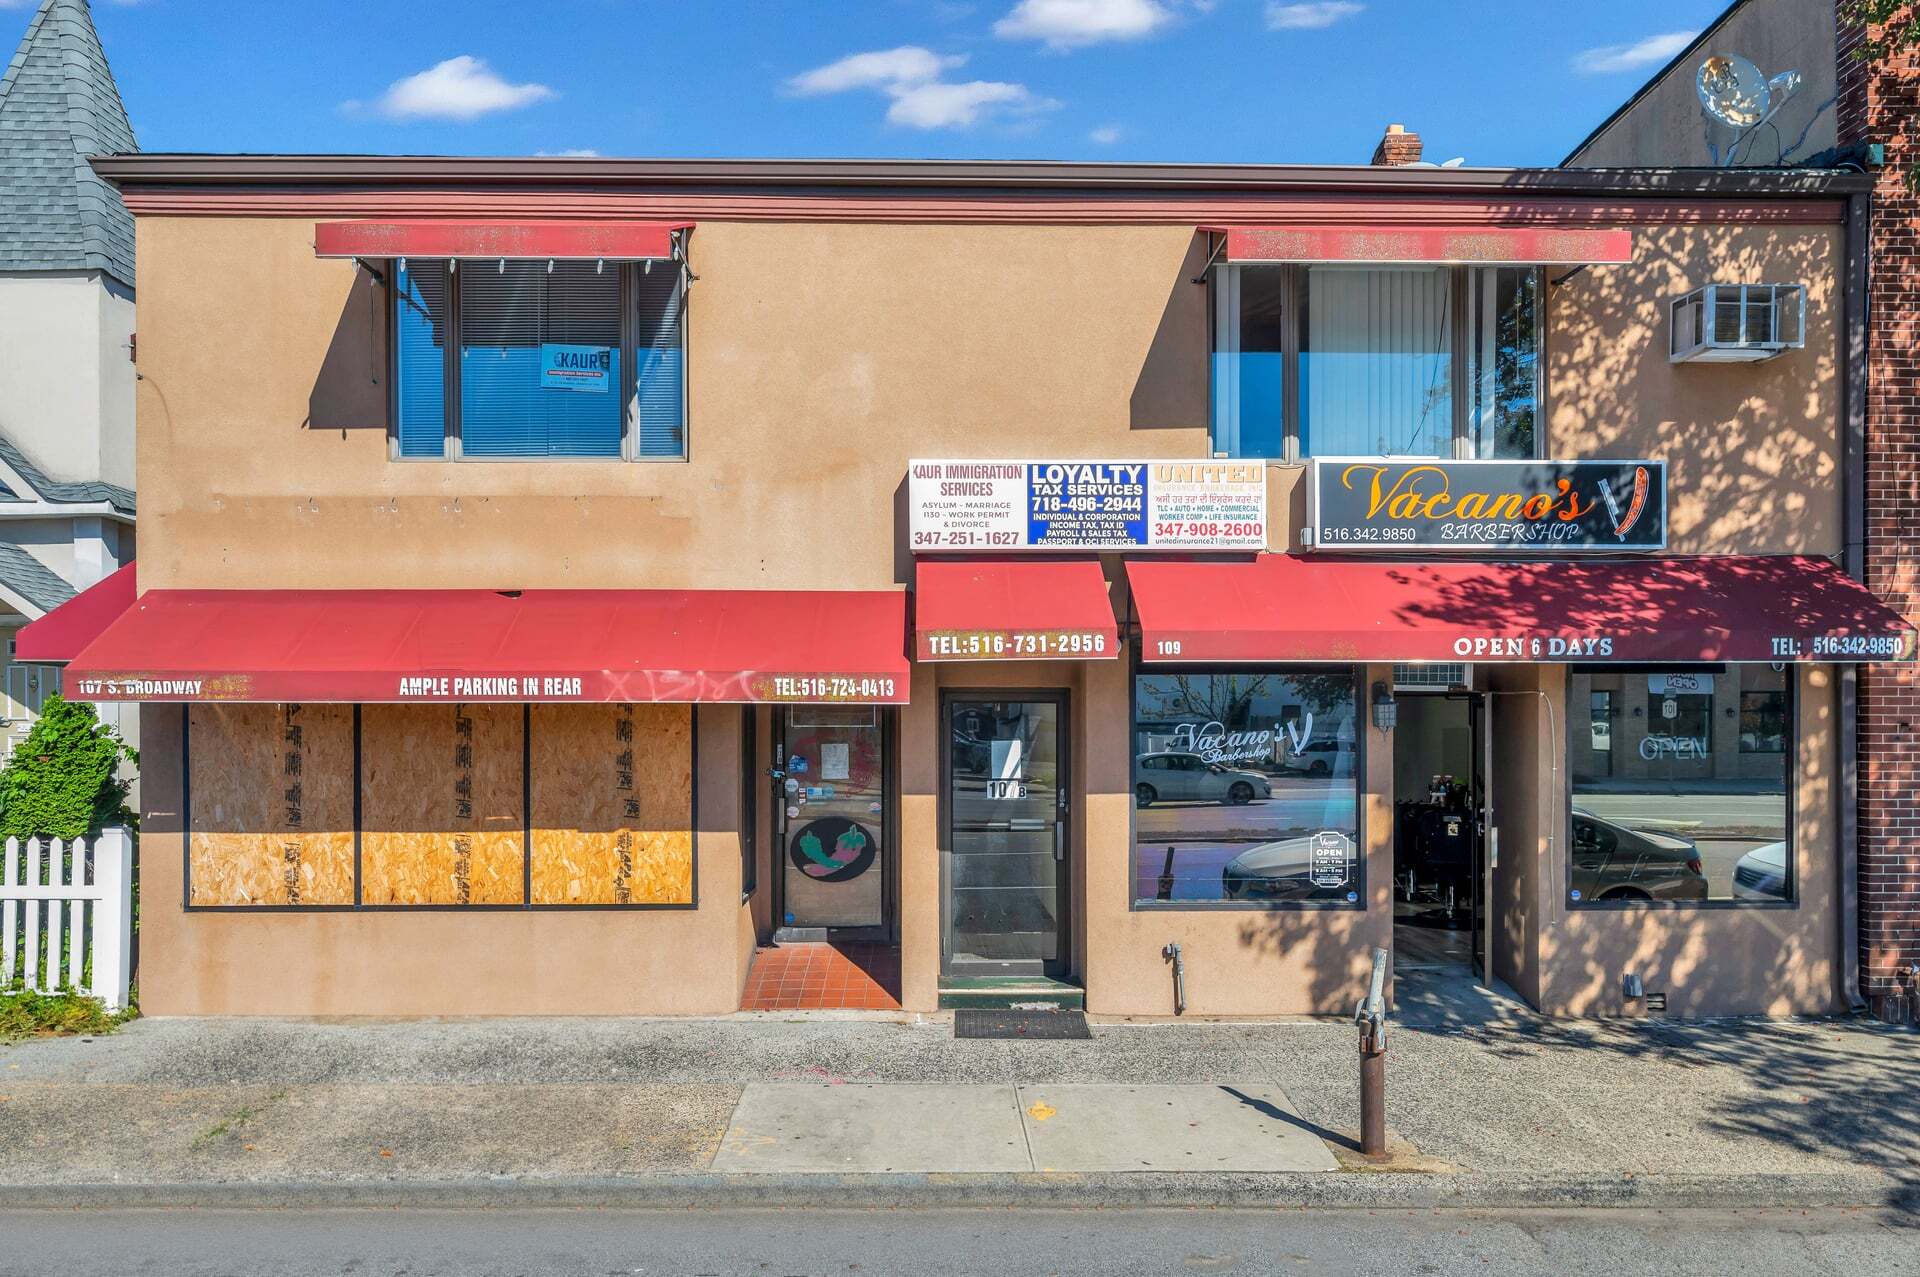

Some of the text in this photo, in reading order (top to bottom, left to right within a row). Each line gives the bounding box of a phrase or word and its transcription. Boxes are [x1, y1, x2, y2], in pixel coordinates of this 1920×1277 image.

[561, 352, 598, 368] KAUR
[913, 465, 1022, 480] KAUR IMMIGRATION
[1032, 464, 1142, 484] LOYALTY
[1154, 464, 1262, 483] UNITED
[940, 482, 993, 496] SERVICES
[1032, 484, 1143, 496] TAX SERVICES
[1342, 465, 1595, 520] Vacano's
[1032, 496, 1142, 512] 718-496-2944
[1082, 522, 1098, 530] TAX,
[1155, 522, 1262, 536] 347-908-2600
[1324, 528, 1416, 540] 516.342.9850
[1440, 523, 1579, 542] BARBERSHOP
[914, 532, 1020, 545] 347-251-1627
[929, 634, 1105, 654] TEL:516-731-2956
[1157, 641, 1181, 655] 109
[1454, 638, 1613, 656] OPEN 6 DAYS
[1772, 637, 1902, 655] TEL: 516-342-9850
[126, 680, 202, 694] BROADWAY
[400, 678, 582, 696] AMPLE PARKING IN REAR
[774, 678, 894, 697] TEL:516-724-0413
[1174, 721, 1286, 752] Vacano's
[1201, 745, 1270, 763] Barbershop
[1640, 736, 1707, 760] OPEN
